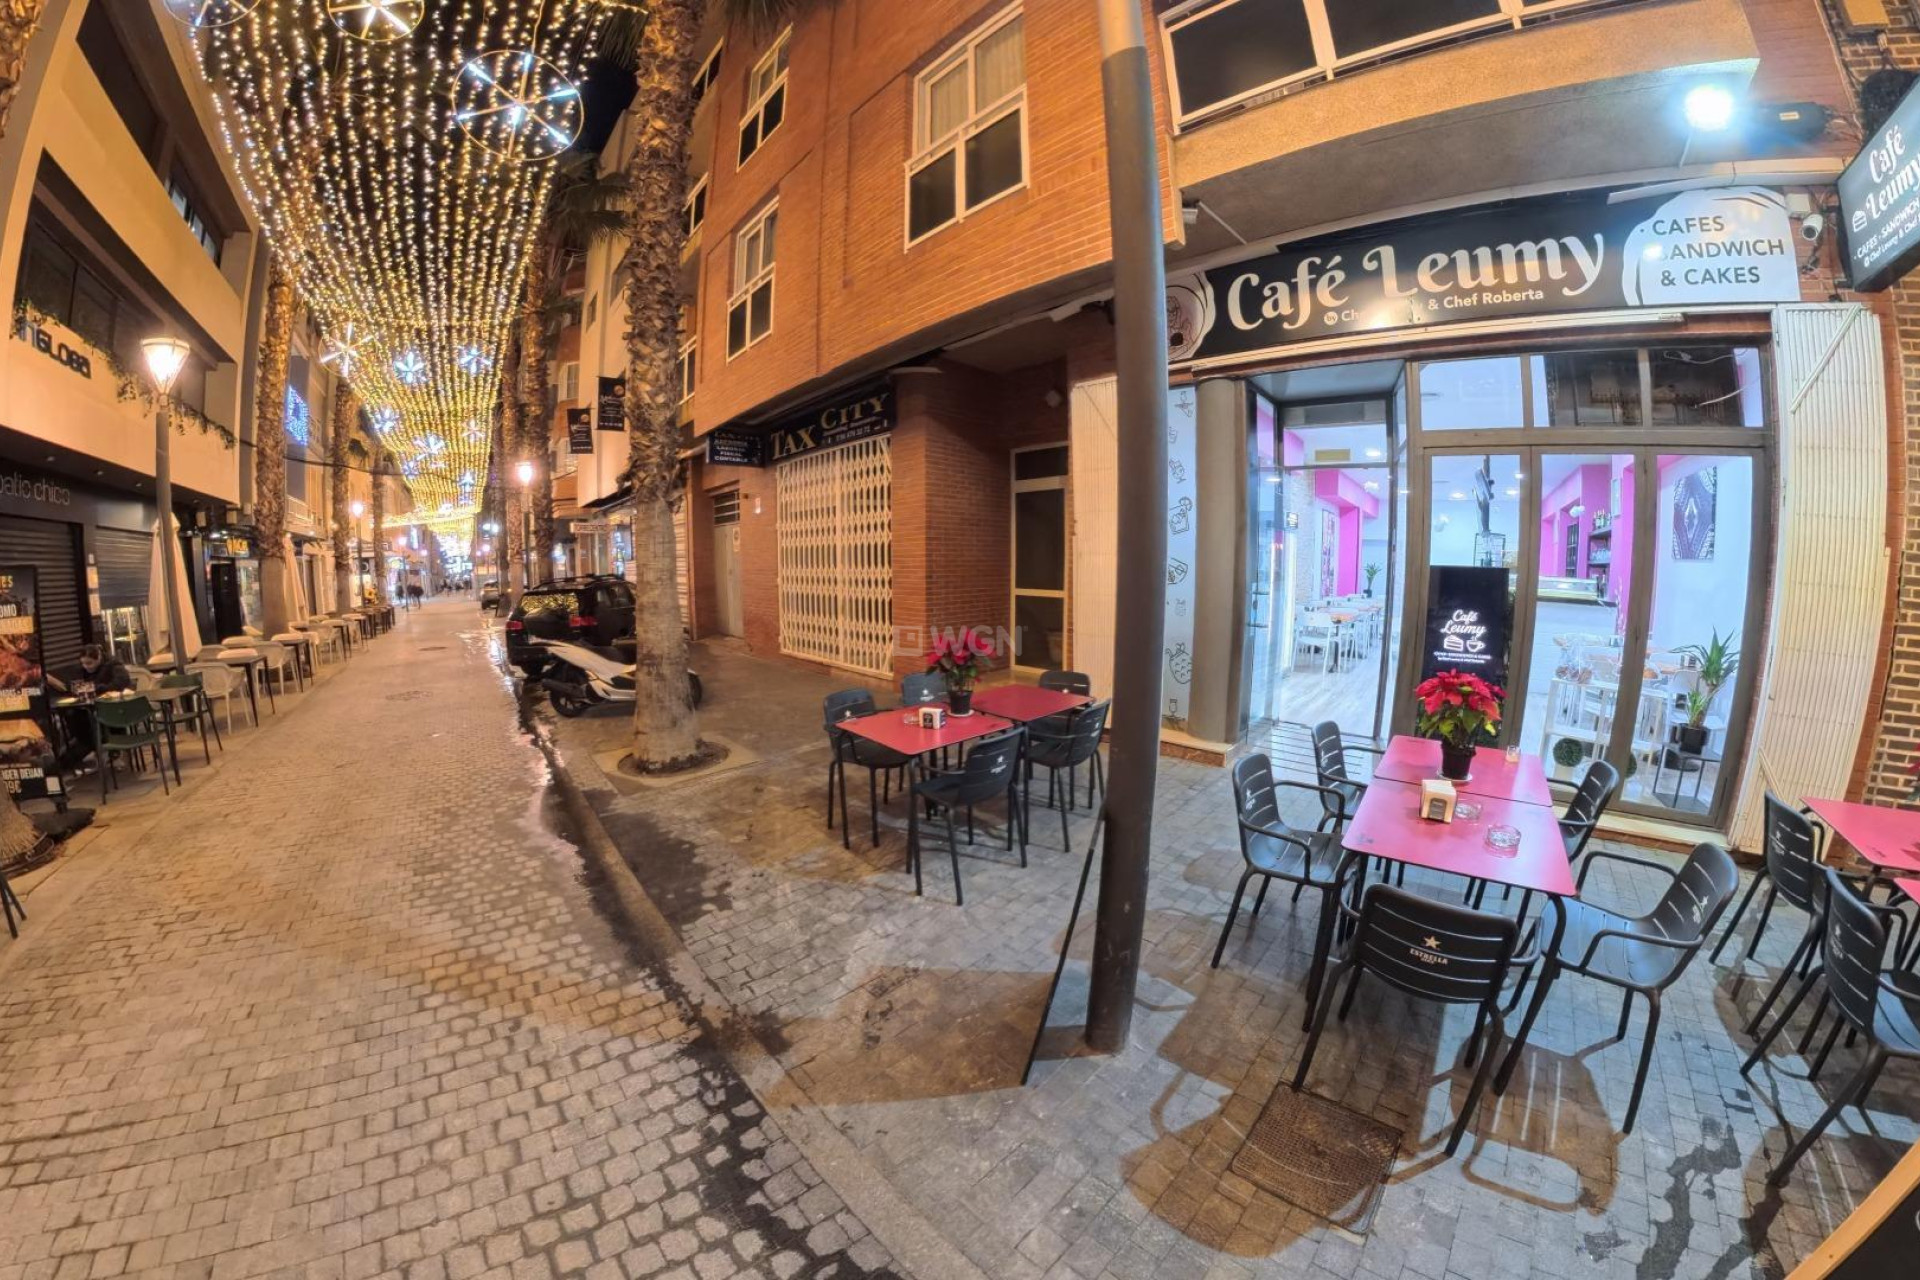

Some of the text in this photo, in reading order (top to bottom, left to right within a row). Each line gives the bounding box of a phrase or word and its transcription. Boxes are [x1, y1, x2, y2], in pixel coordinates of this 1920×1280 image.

[1869, 124, 1906, 184] Café
[1652, 216, 1725, 236] CAFES
[1662, 239, 1785, 262] ANDWICH
[1227, 233, 1604, 330] Café Leumy
[1661, 266, 1760, 286] & CAKES
[1428, 298, 1439, 310] &
[1443, 293, 1478, 309] Chef
[1483, 288, 1544, 305] Roberta
[770, 425, 817, 460] TAX
[1440, 619, 1487, 638] Leumy
